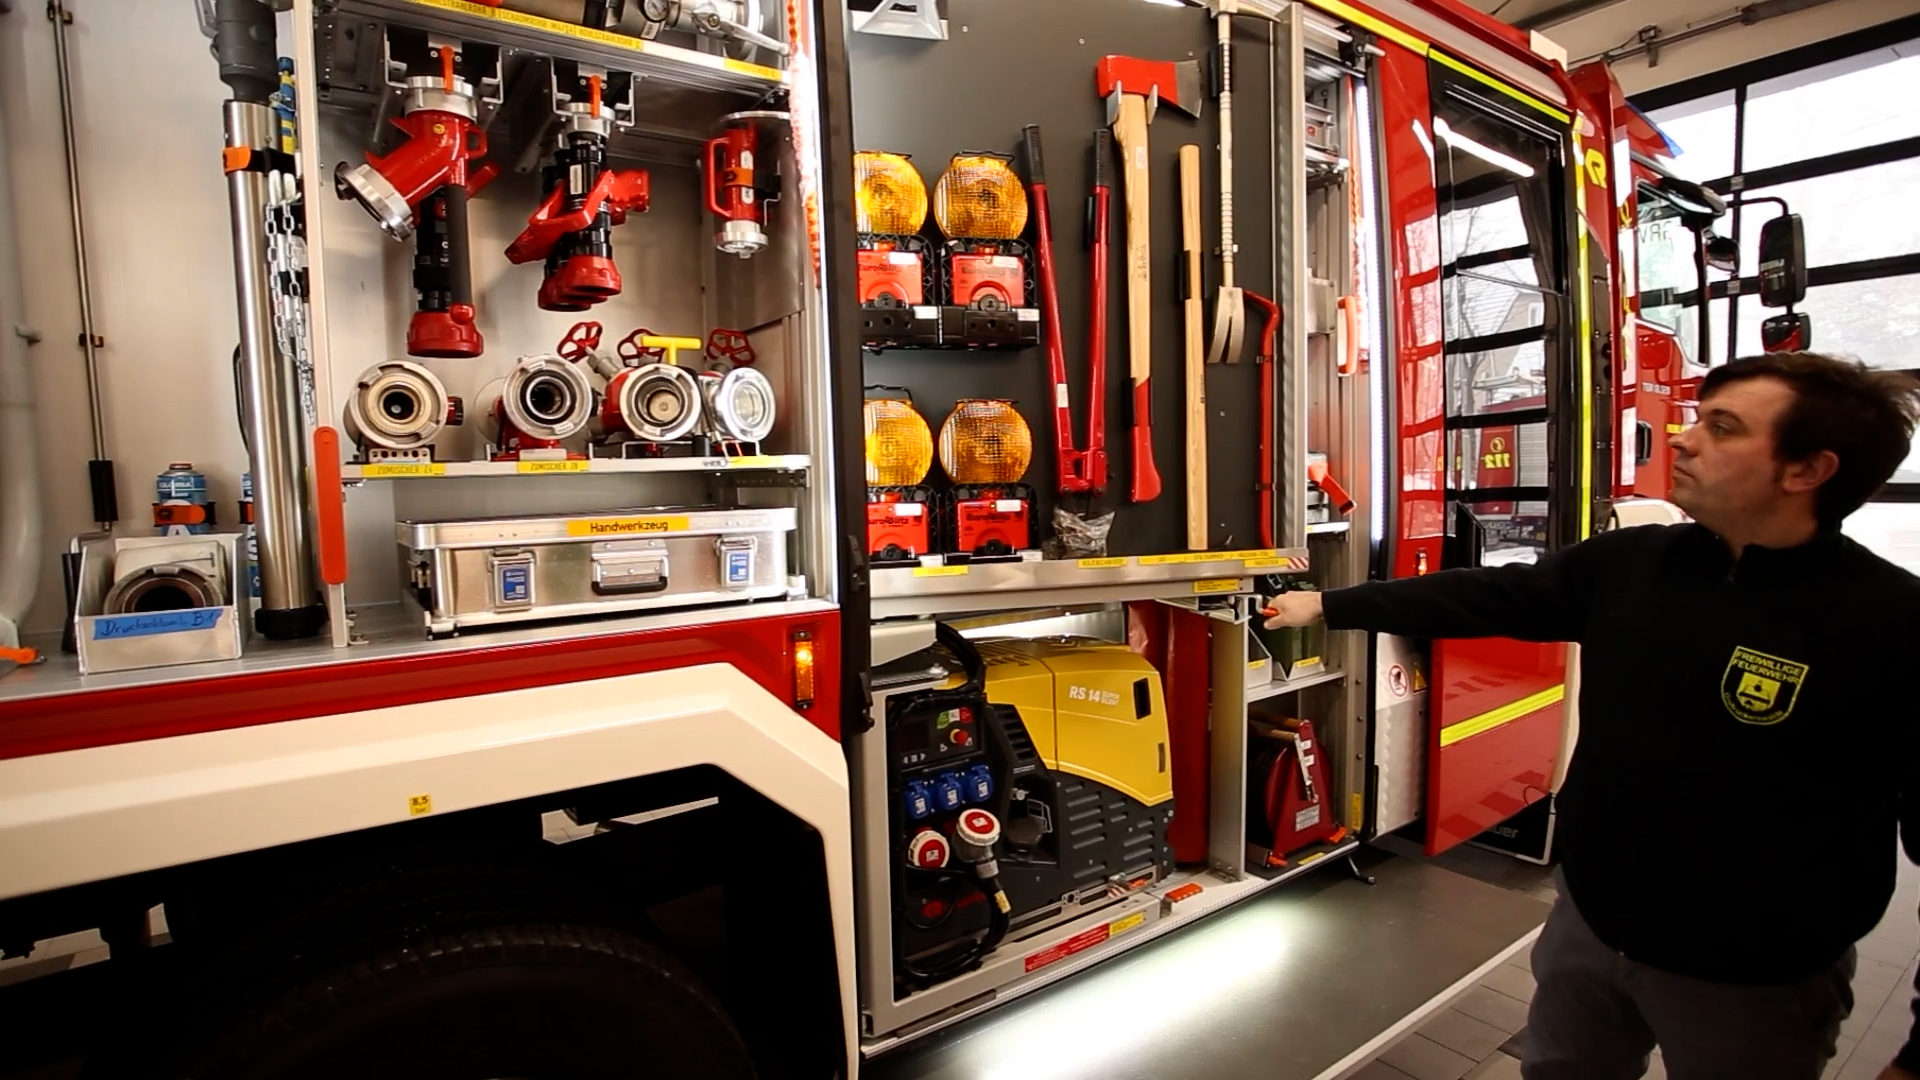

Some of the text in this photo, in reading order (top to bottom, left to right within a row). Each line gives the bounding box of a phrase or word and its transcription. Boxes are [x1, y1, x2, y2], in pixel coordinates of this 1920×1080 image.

[377, 464, 420, 475] ZUMISCHER
[530, 462, 567, 471] ZUMISCHER
[590, 521, 669, 532] Handwerkzeug
[1734, 650, 1802, 677] FREIWILLIGE
[1731, 660, 1800, 684] FEUERWEHR
[1069, 685, 1100, 702] RS 14
